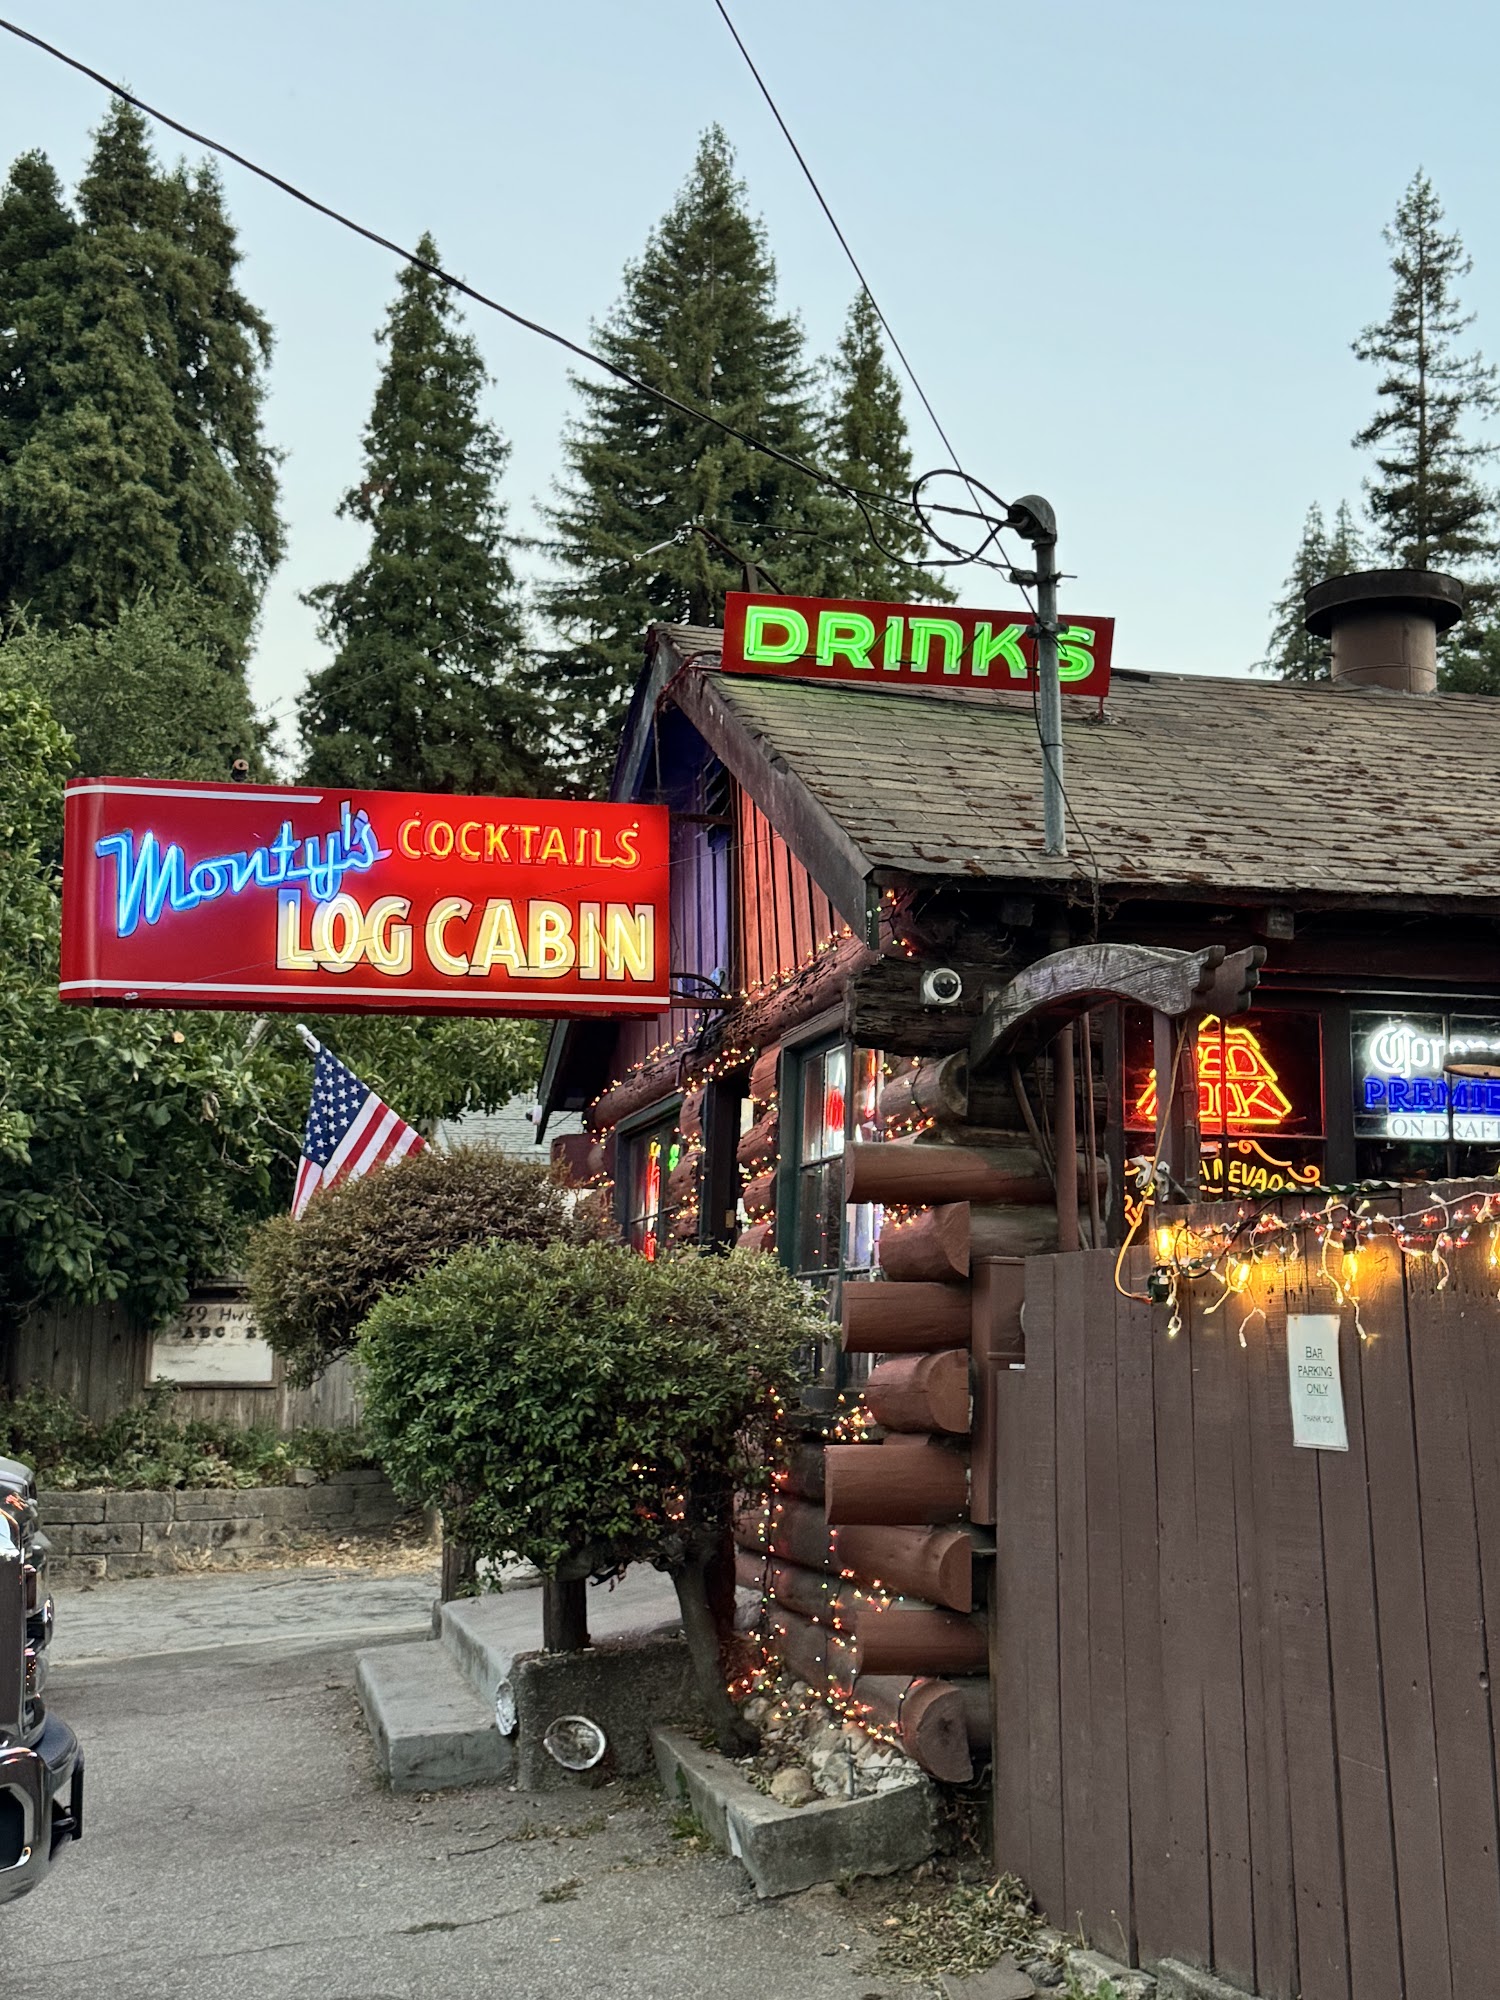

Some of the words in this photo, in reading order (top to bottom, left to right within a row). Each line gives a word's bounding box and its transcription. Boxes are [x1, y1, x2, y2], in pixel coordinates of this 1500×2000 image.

[743, 604, 1096, 683] DRINKS
[397, 812, 642, 870] COCKTAILS
[95, 800, 393, 938] Monty's
[276, 888, 414, 977] LOG
[424, 897, 656, 982] CABIN
[1197, 1045, 1258, 1077] ED
[1392, 1119, 1424, 1137] ON
[1213, 1159, 1298, 1191] NEVAD
[1297, 1365, 1333, 1377] PARKING
[1306, 1382, 1329, 1395] ONLY
[1303, 1414, 1321, 1423] THANK
[1321, 1415, 1334, 1424] YOU
